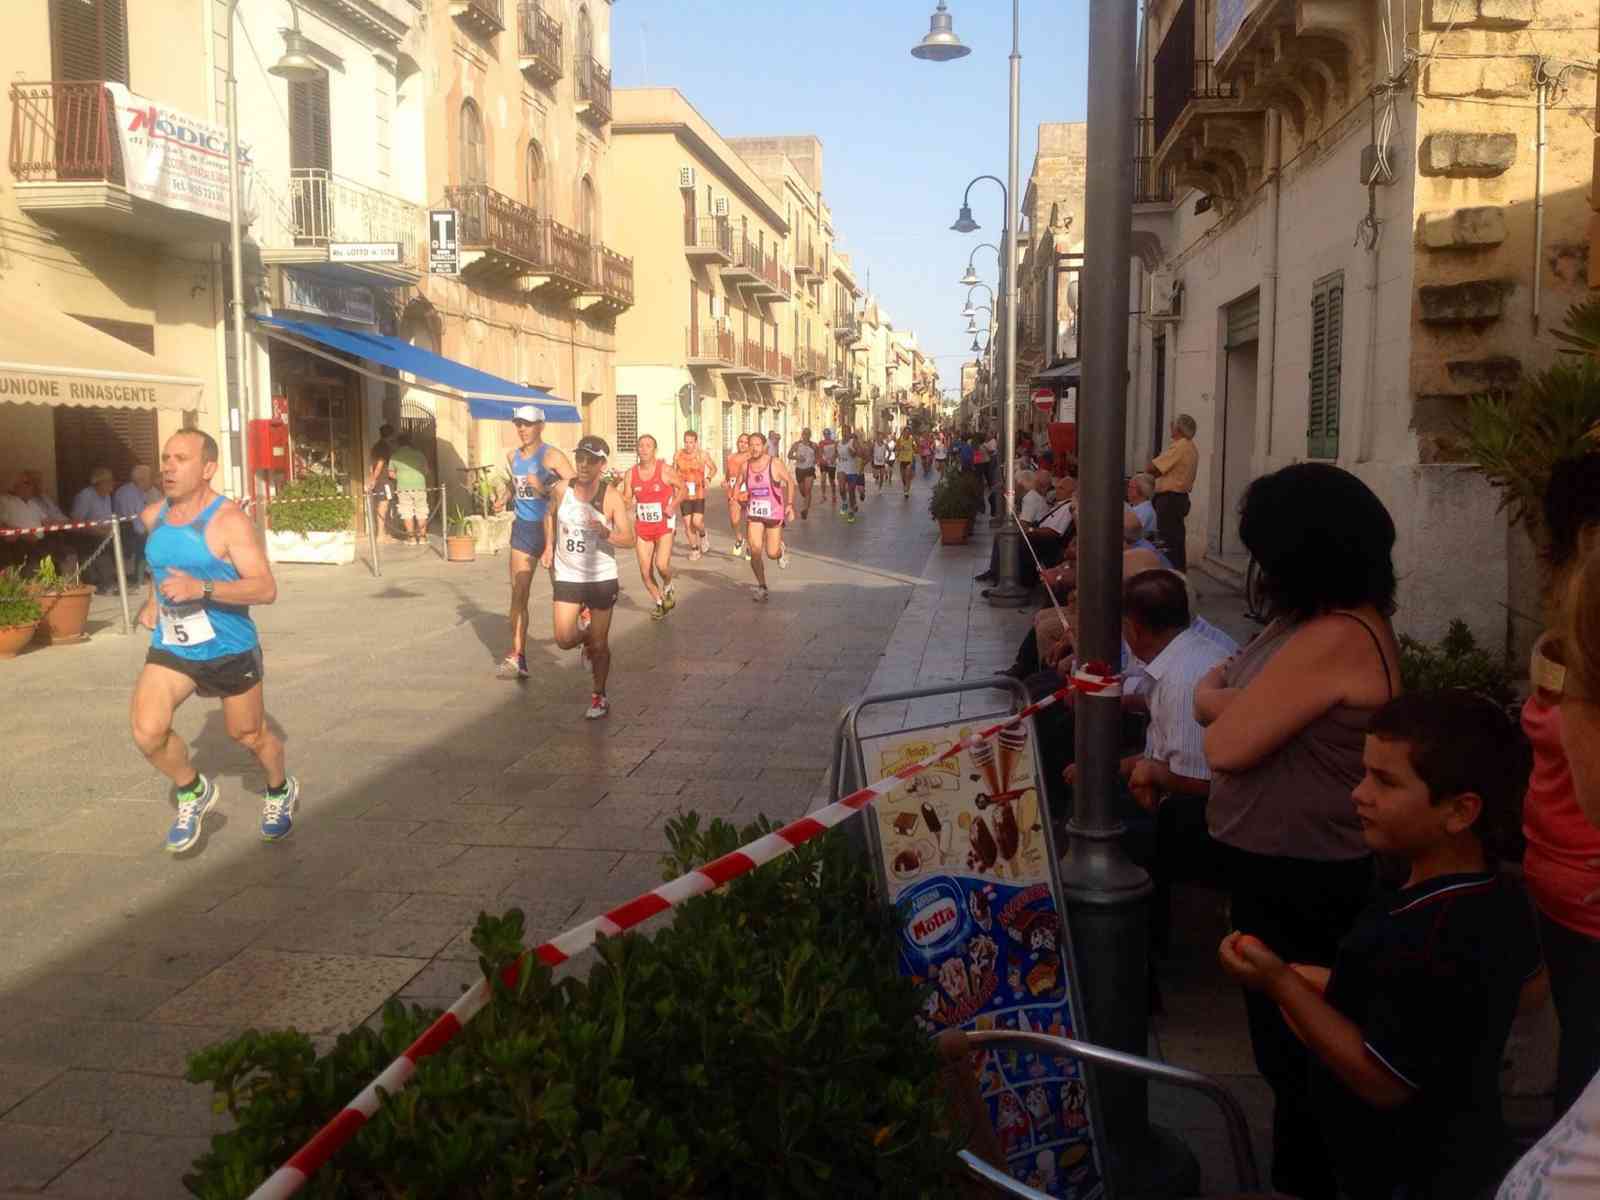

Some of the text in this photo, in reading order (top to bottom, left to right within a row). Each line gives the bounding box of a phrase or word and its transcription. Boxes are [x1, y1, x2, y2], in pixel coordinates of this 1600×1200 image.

[0, 377, 157, 402] UNIONE RINASCENTE
[566, 538, 586, 553] 85
[174, 624, 190, 643] 5
[912, 904, 956, 940] Motta
